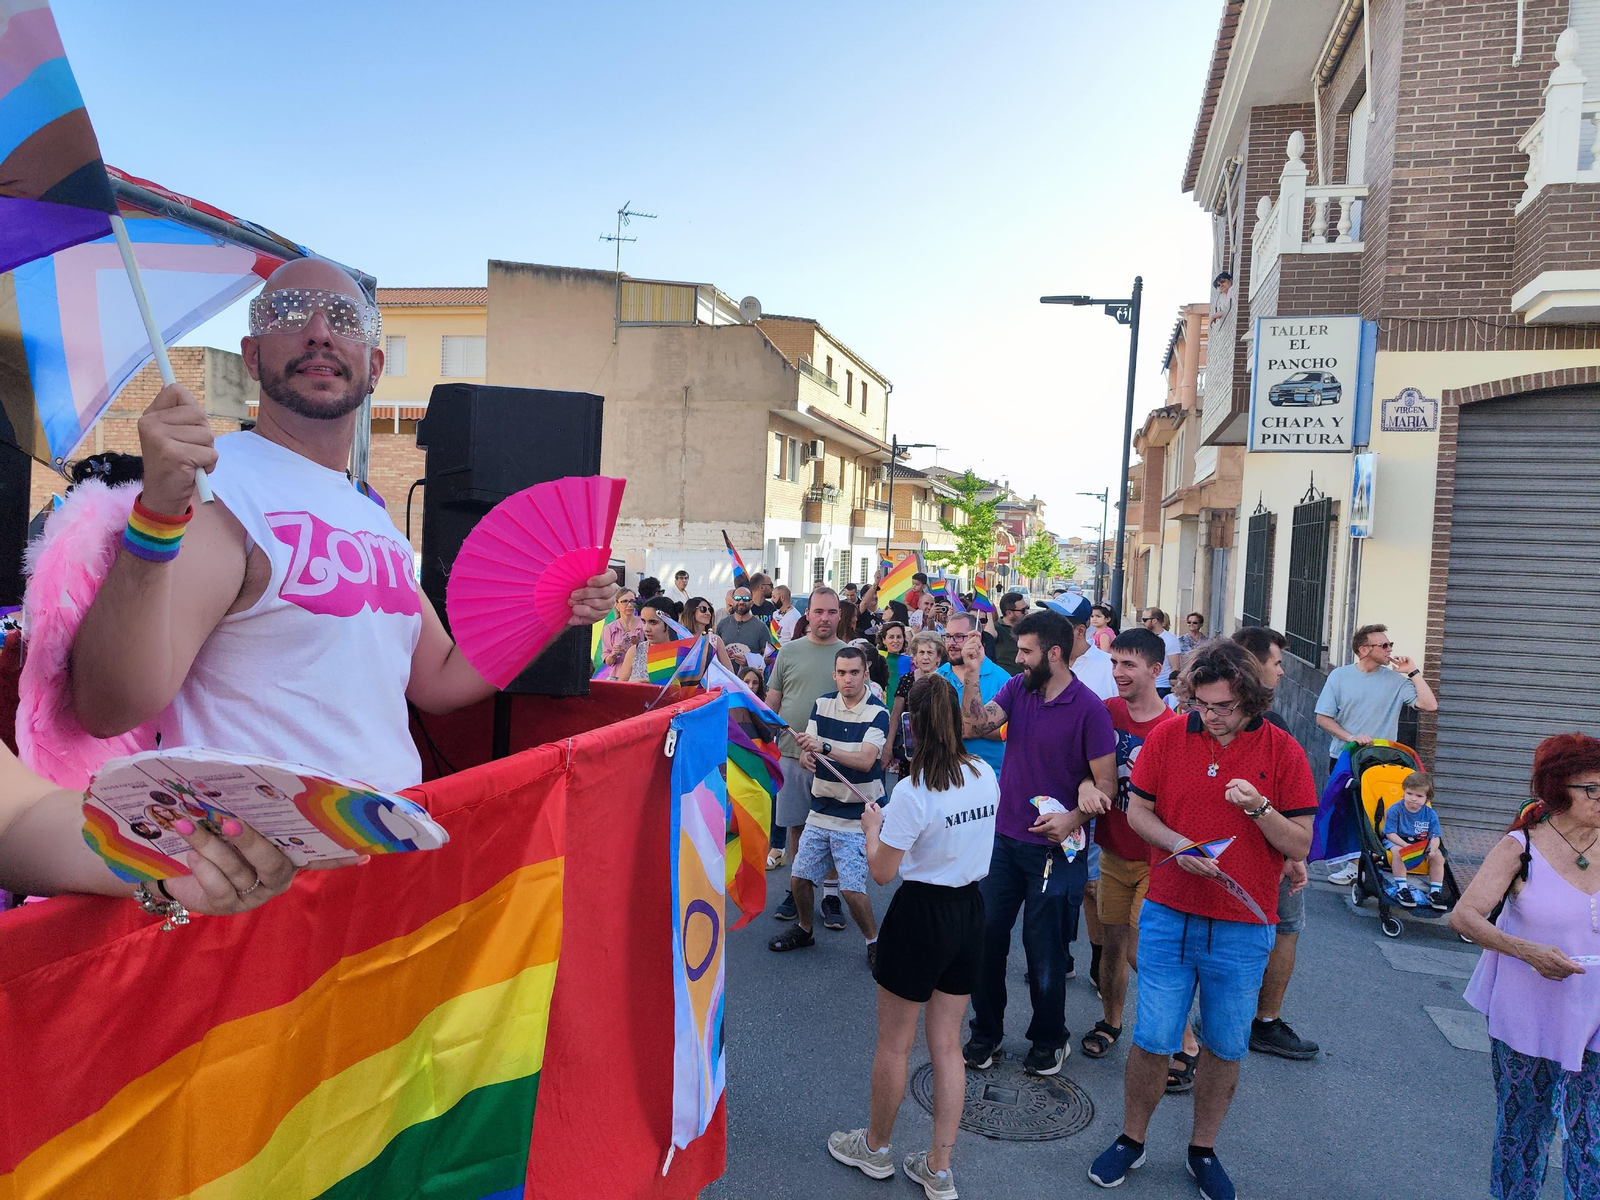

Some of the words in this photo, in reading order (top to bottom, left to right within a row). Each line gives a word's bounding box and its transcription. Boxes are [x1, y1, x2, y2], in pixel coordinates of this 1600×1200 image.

[1269, 325, 1329, 336] TALLER
[1289, 339, 1311, 350] EL
[1267, 357, 1338, 371] PANCHO
[1394, 406, 1425, 414] VIRGEN
[1261, 416, 1325, 429] CHAPA
[1331, 416, 1345, 428] Y
[1389, 415, 1429, 428] MARIA
[1260, 433, 1345, 445] PINTURA
[945, 804, 995, 829] NATALIA
